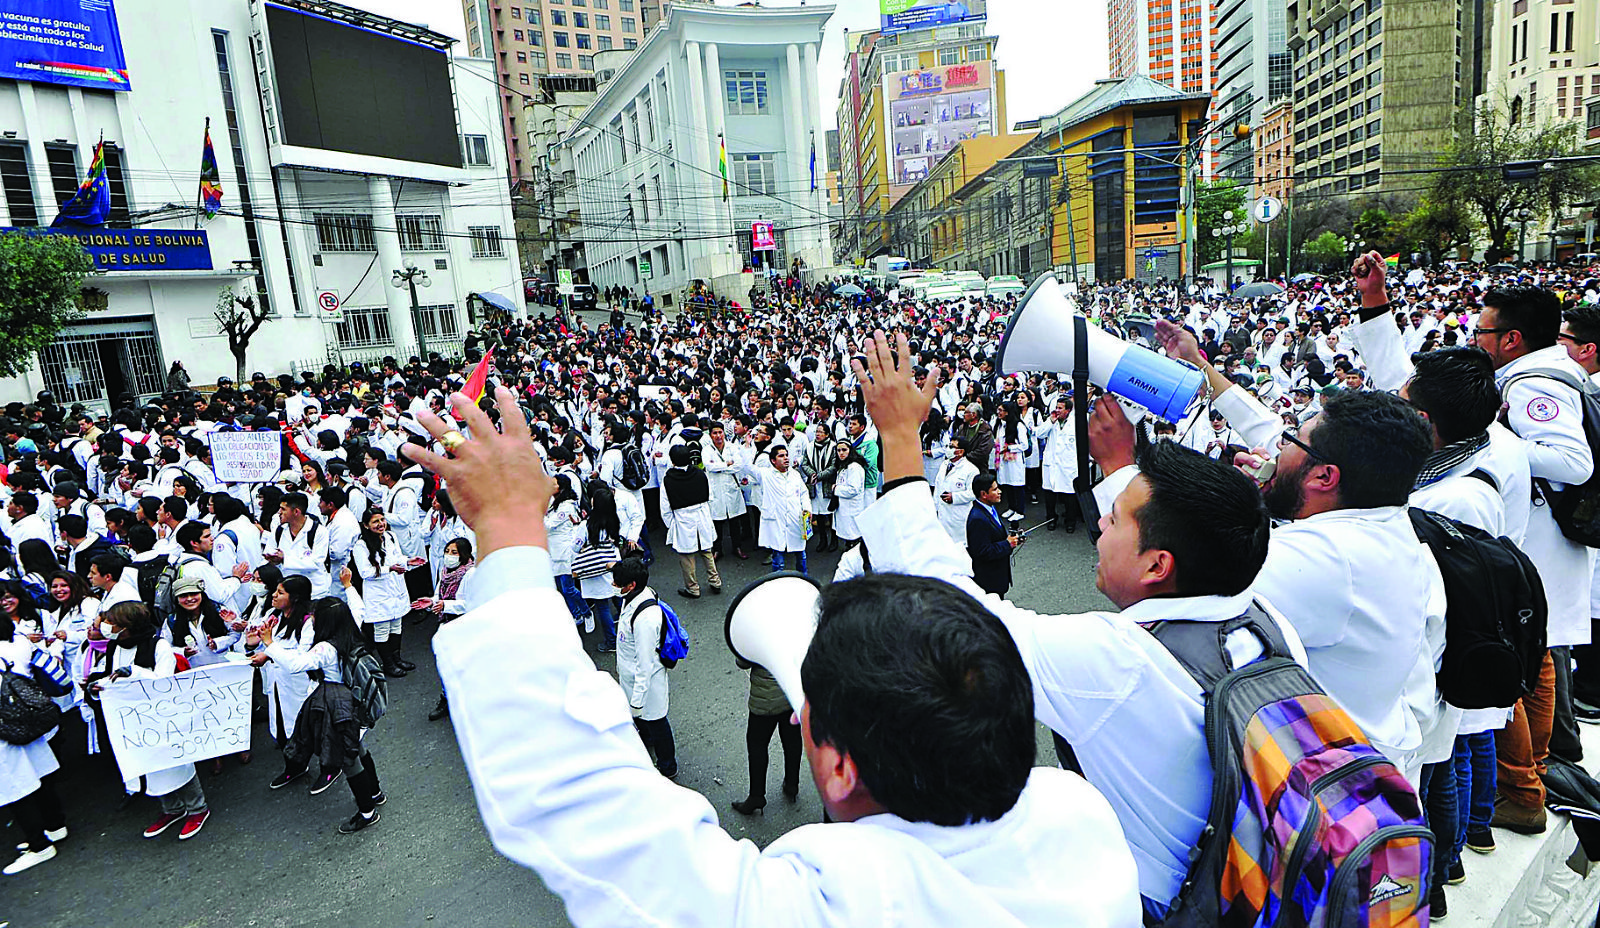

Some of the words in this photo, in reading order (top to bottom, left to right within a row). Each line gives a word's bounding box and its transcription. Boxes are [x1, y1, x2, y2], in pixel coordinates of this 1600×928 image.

[3, 12, 40, 24] vacuna
[54, 20, 90, 32] gratuita
[7, 22, 28, 32] está
[44, 27, 70, 38] todos
[72, 31, 85, 40] los
[66, 40, 78, 48] de
[79, 41, 104, 52] Salud
[134, 235, 150, 246] DE
[156, 234, 204, 246] BOLIVIA
[100, 252, 117, 264] DE
[122, 252, 166, 264] SALUD
[1128, 376, 1158, 396] ARMIN
[212, 432, 222, 442] LA
[223, 432, 245, 442] SALUD
[247, 432, 271, 442] ANTES
[240, 470, 264, 478] ESTADO
[116, 680, 251, 730] PRESENTE
[122, 728, 162, 750] NO
[166, 720, 184, 742] A
[188, 710, 222, 734] LA
